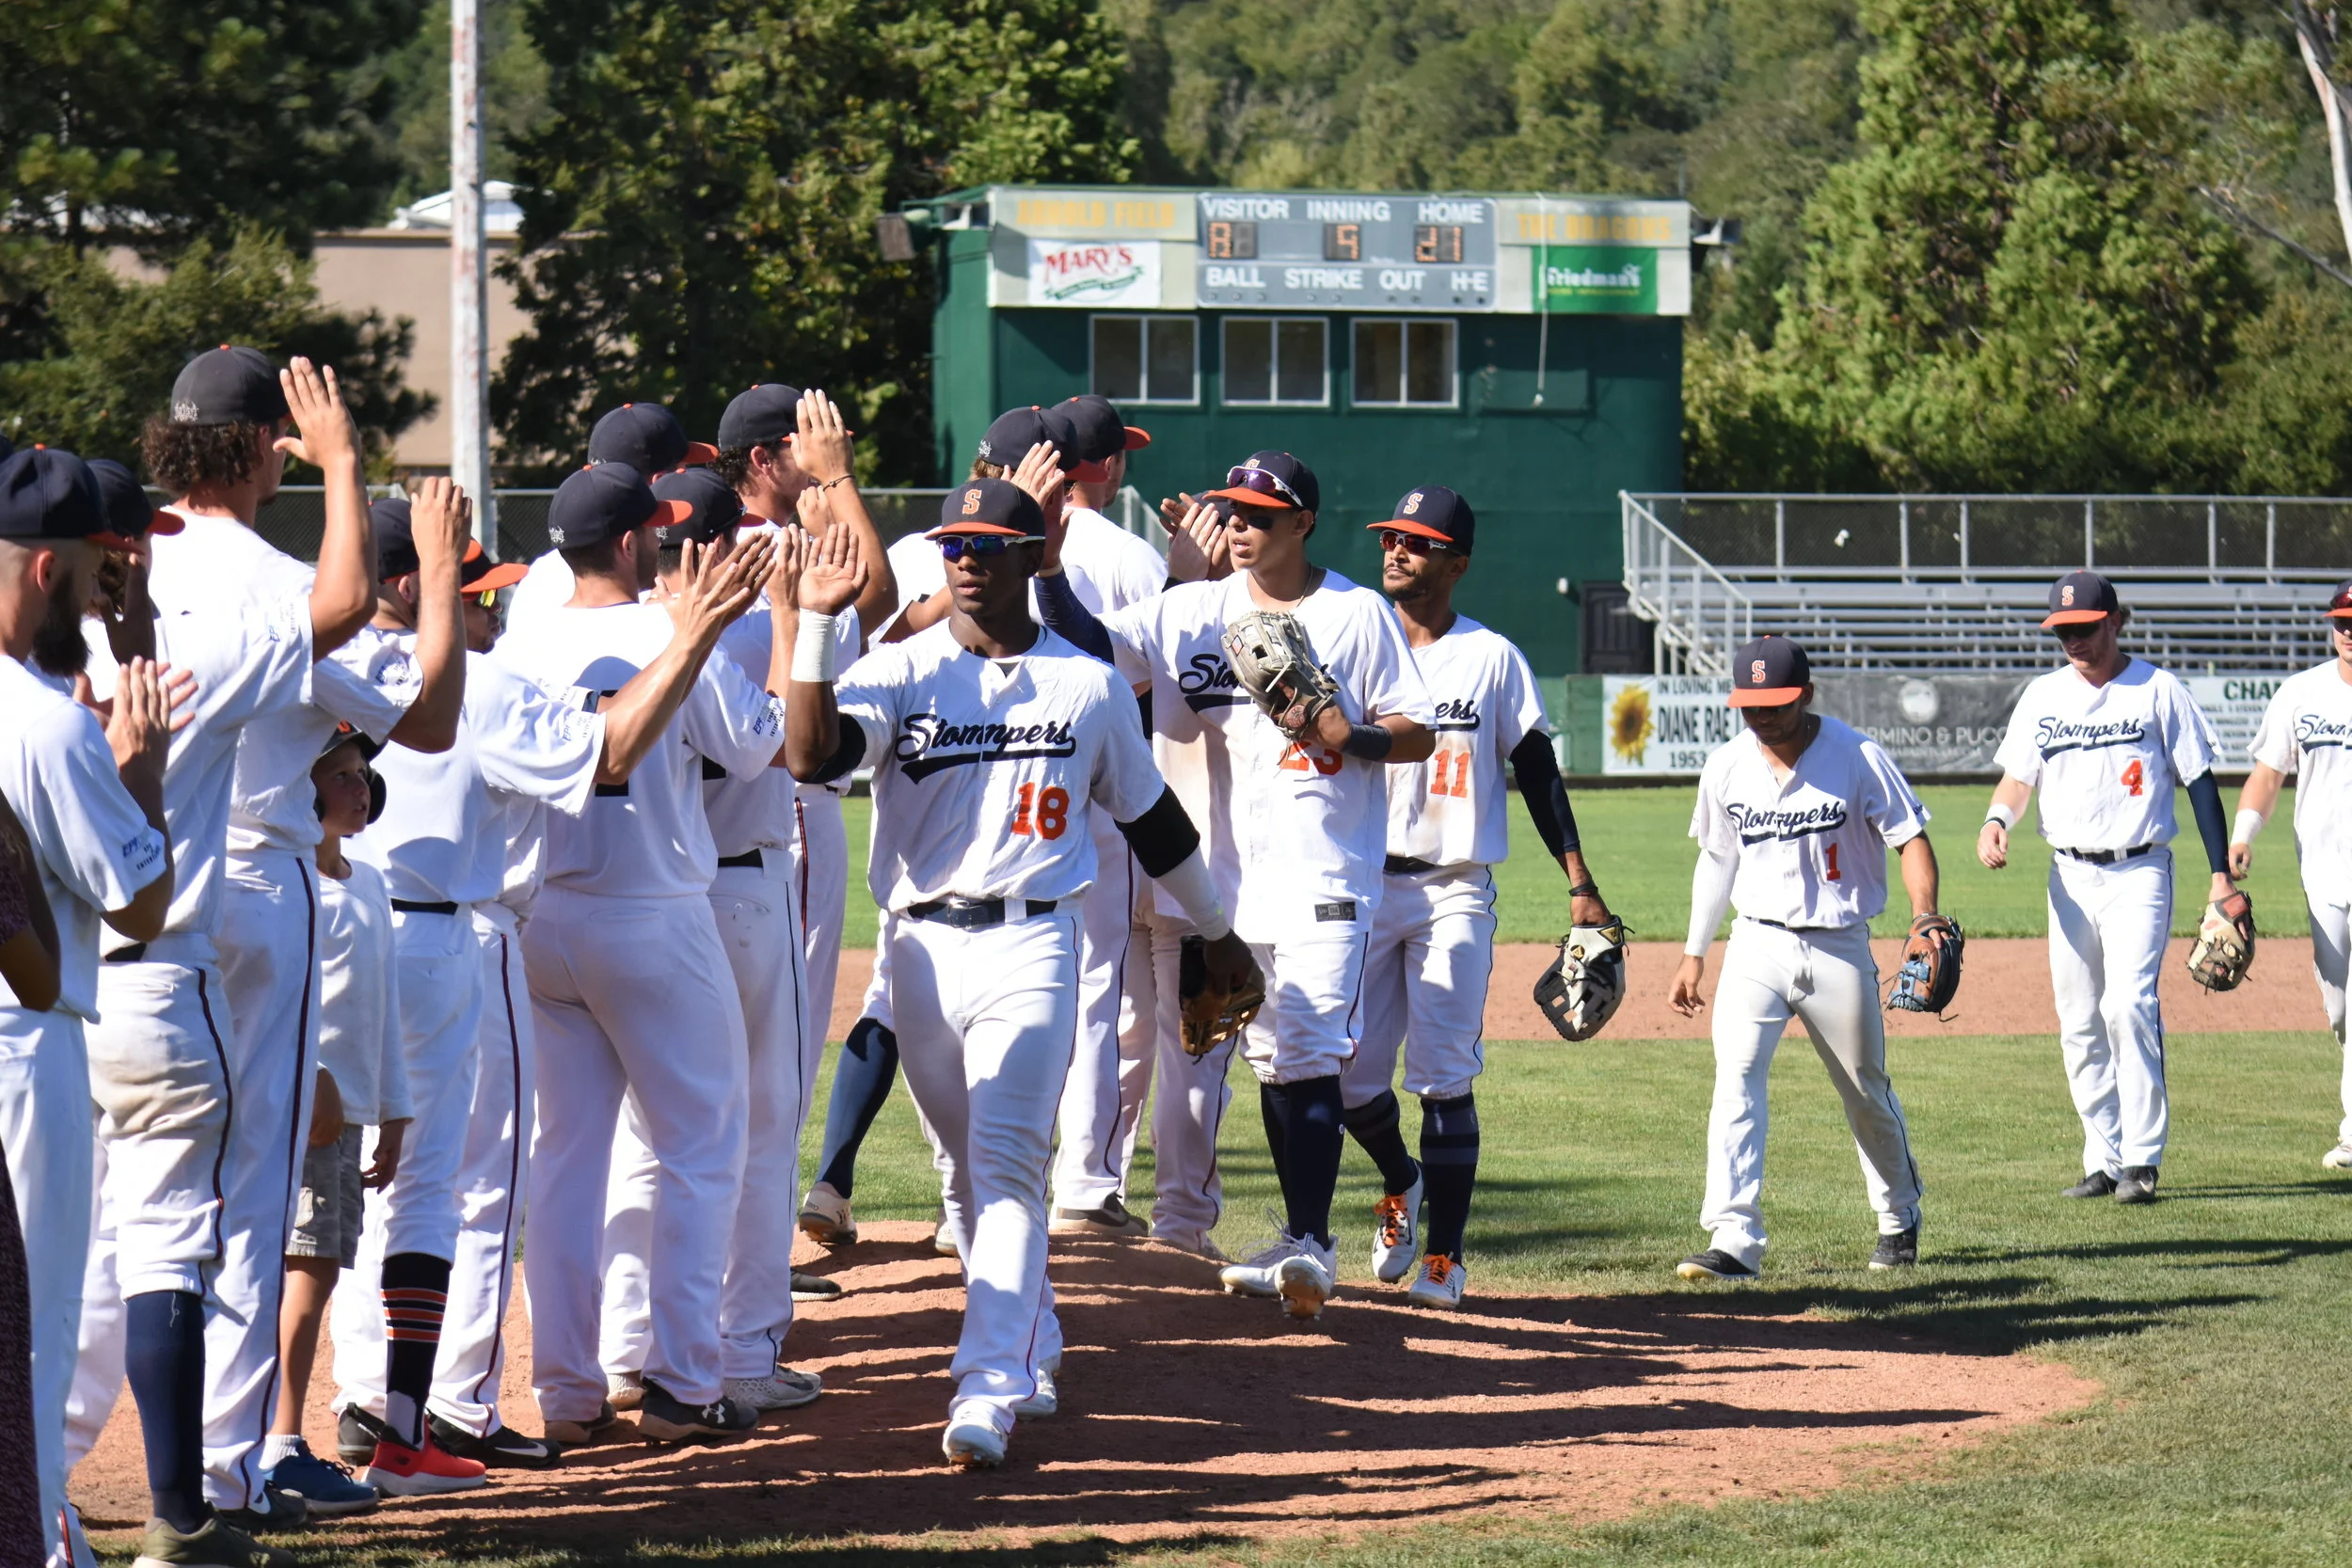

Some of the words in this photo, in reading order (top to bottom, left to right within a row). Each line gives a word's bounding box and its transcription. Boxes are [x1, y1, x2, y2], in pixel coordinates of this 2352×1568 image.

[1115, 201, 1175, 229] FIELD
[1201, 198, 1290, 219] VISITOR
[1306, 200, 1391, 222] INNING
[1418, 201, 1485, 224] HOME
[1043, 242, 1135, 283] MARY'S
[1205, 267, 1267, 288] BALL
[1284, 268, 1363, 290] STRIKE
[1378, 269, 1427, 291] OUT
[961, 488, 982, 515] S
[1403, 492, 1424, 515] S
[2061, 585, 2074, 607] S
[1752, 659, 1766, 683] S
[1658, 679, 1669, 693] IN
[1673, 678, 1712, 693] LOVING
[1716, 679, 1735, 693] ME
[1658, 706, 1699, 742] DIANE
[1705, 706, 1731, 742] RAE
[1936, 726, 1951, 746] &
[2035, 717, 2144, 748] Stompers
[897, 713, 1075, 762] Stompers
[1430, 749, 1470, 799] 11
[2121, 759, 2143, 797] 4
[1011, 782, 1070, 841] 18
[1726, 800, 1847, 834] Stompers
[1824, 843, 1841, 881] 1
